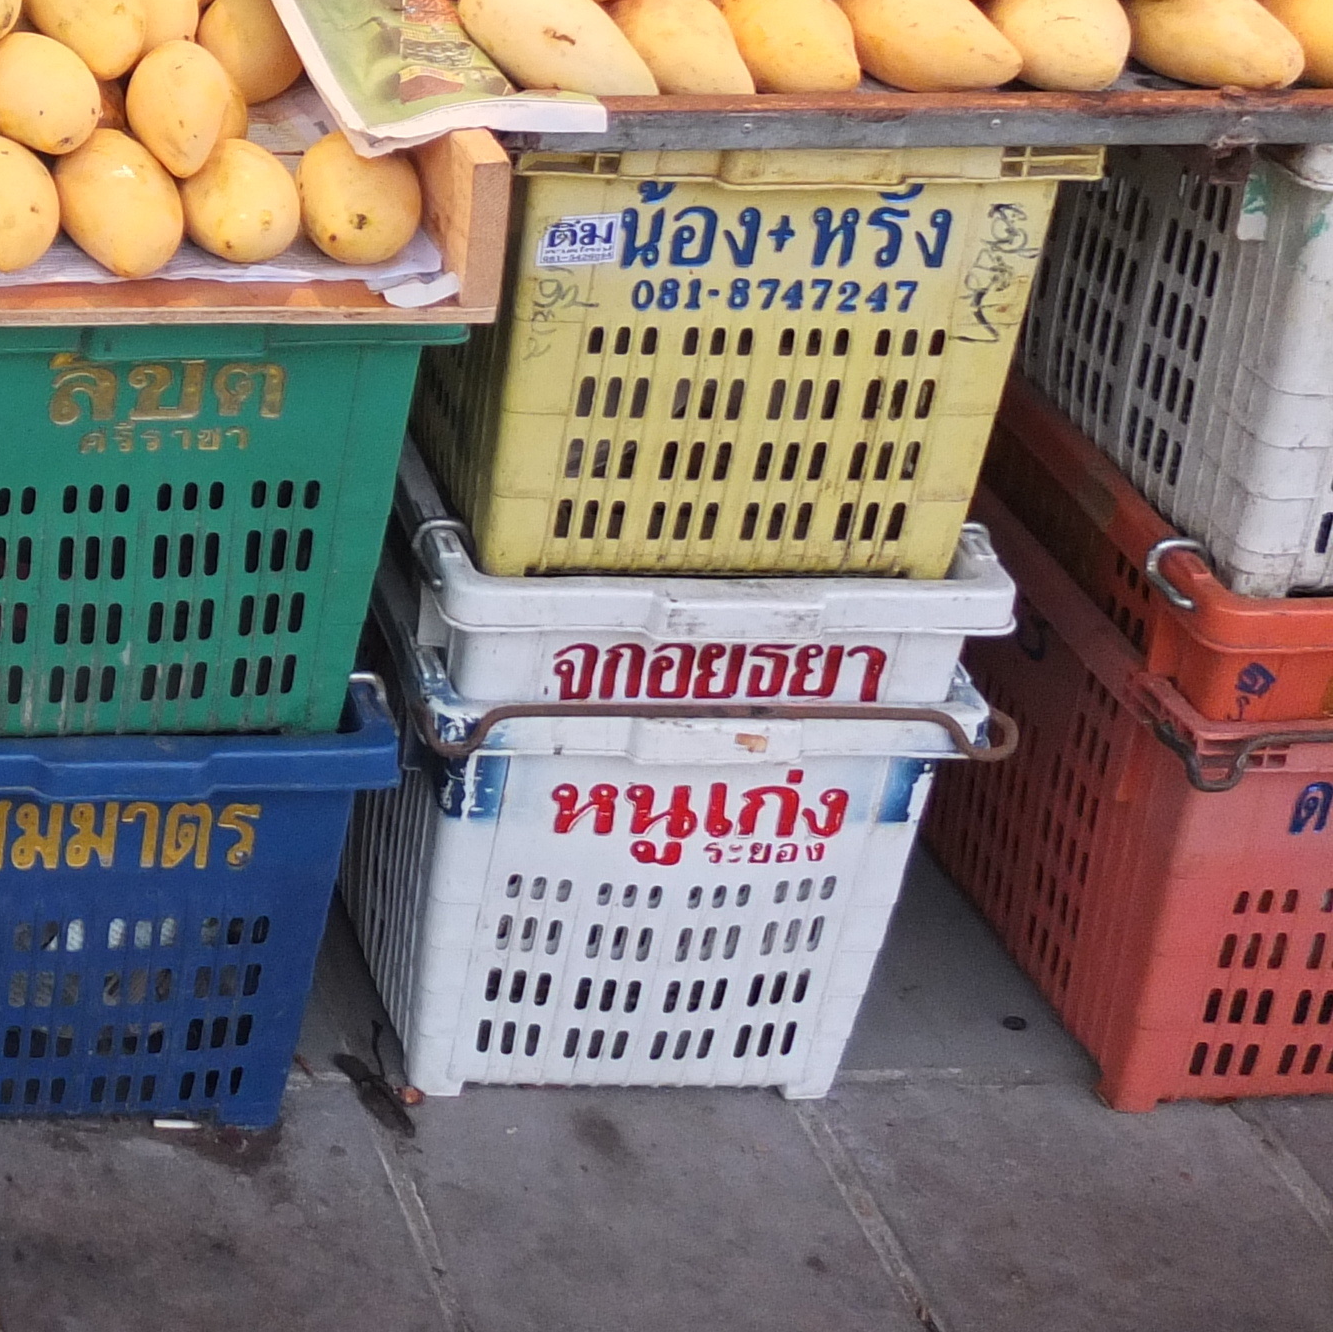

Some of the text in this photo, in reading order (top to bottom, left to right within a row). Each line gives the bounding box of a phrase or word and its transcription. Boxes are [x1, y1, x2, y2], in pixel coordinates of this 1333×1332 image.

[632, 277, 919, 313] 081-8747247
[551, 769, 849, 866] หนูเก่ง
[704, 841, 825, 864] ระยอง
